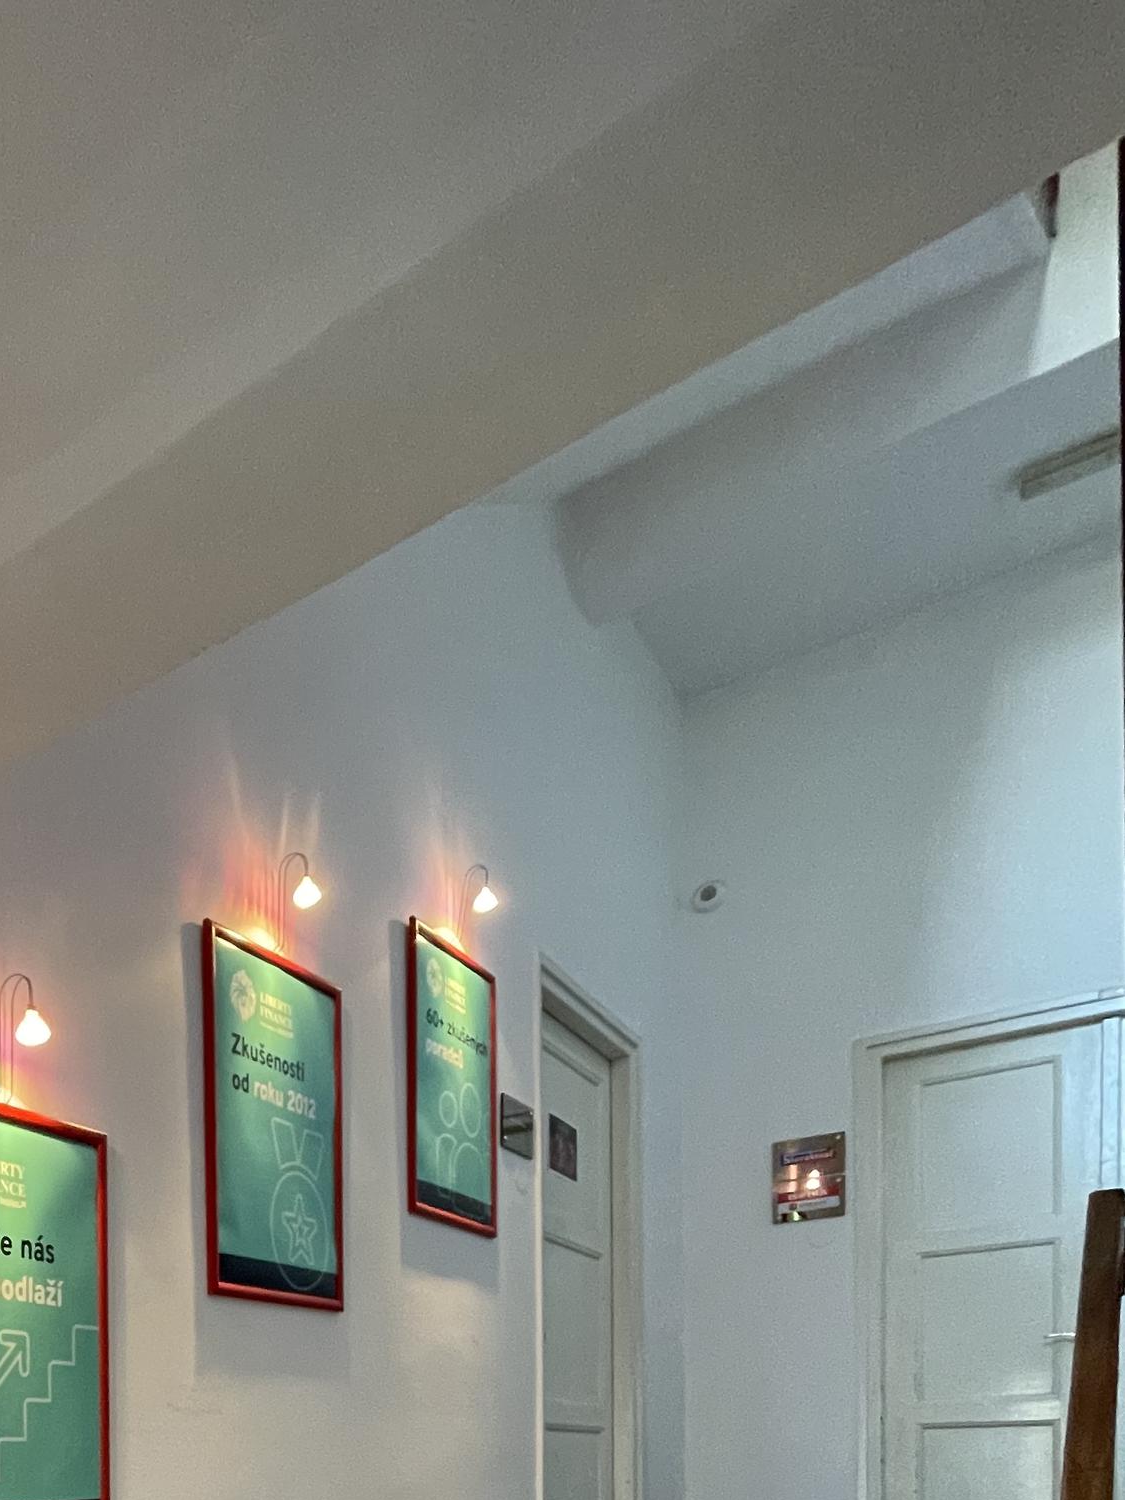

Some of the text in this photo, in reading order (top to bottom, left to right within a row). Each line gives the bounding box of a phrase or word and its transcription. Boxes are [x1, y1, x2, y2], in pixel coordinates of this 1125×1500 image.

[231, 1032, 305, 1082] Zkušenosti
[232, 1072, 316, 1119] od roku 2012
[21, 1234, 55, 1264] nás
